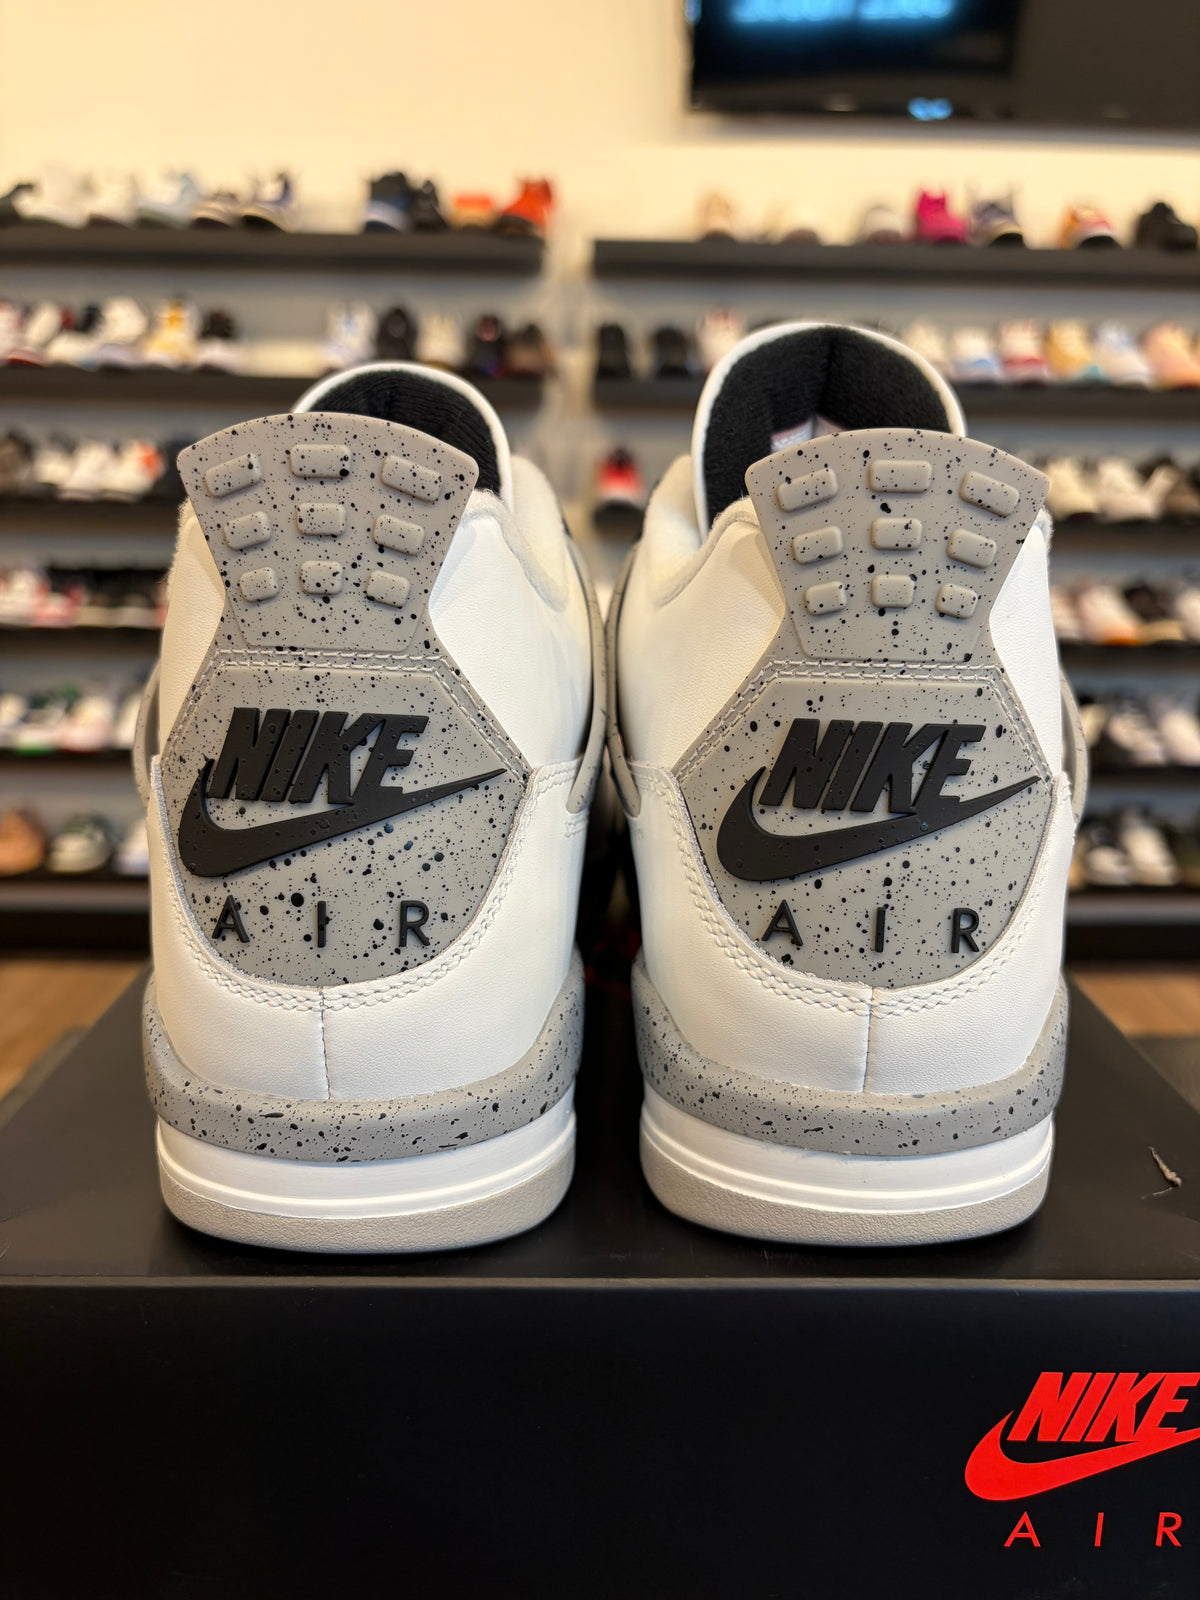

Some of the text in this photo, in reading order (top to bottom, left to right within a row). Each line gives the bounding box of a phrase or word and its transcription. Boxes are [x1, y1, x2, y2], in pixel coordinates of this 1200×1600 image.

[206, 707, 429, 805] NIKE
[758, 718, 986, 814] NIKE
[211, 895, 430, 948] AIR
[761, 899, 980, 953] AIR
[1006, 1371, 1200, 1442] NIKE
[1003, 1511, 1182, 1547] AIR
